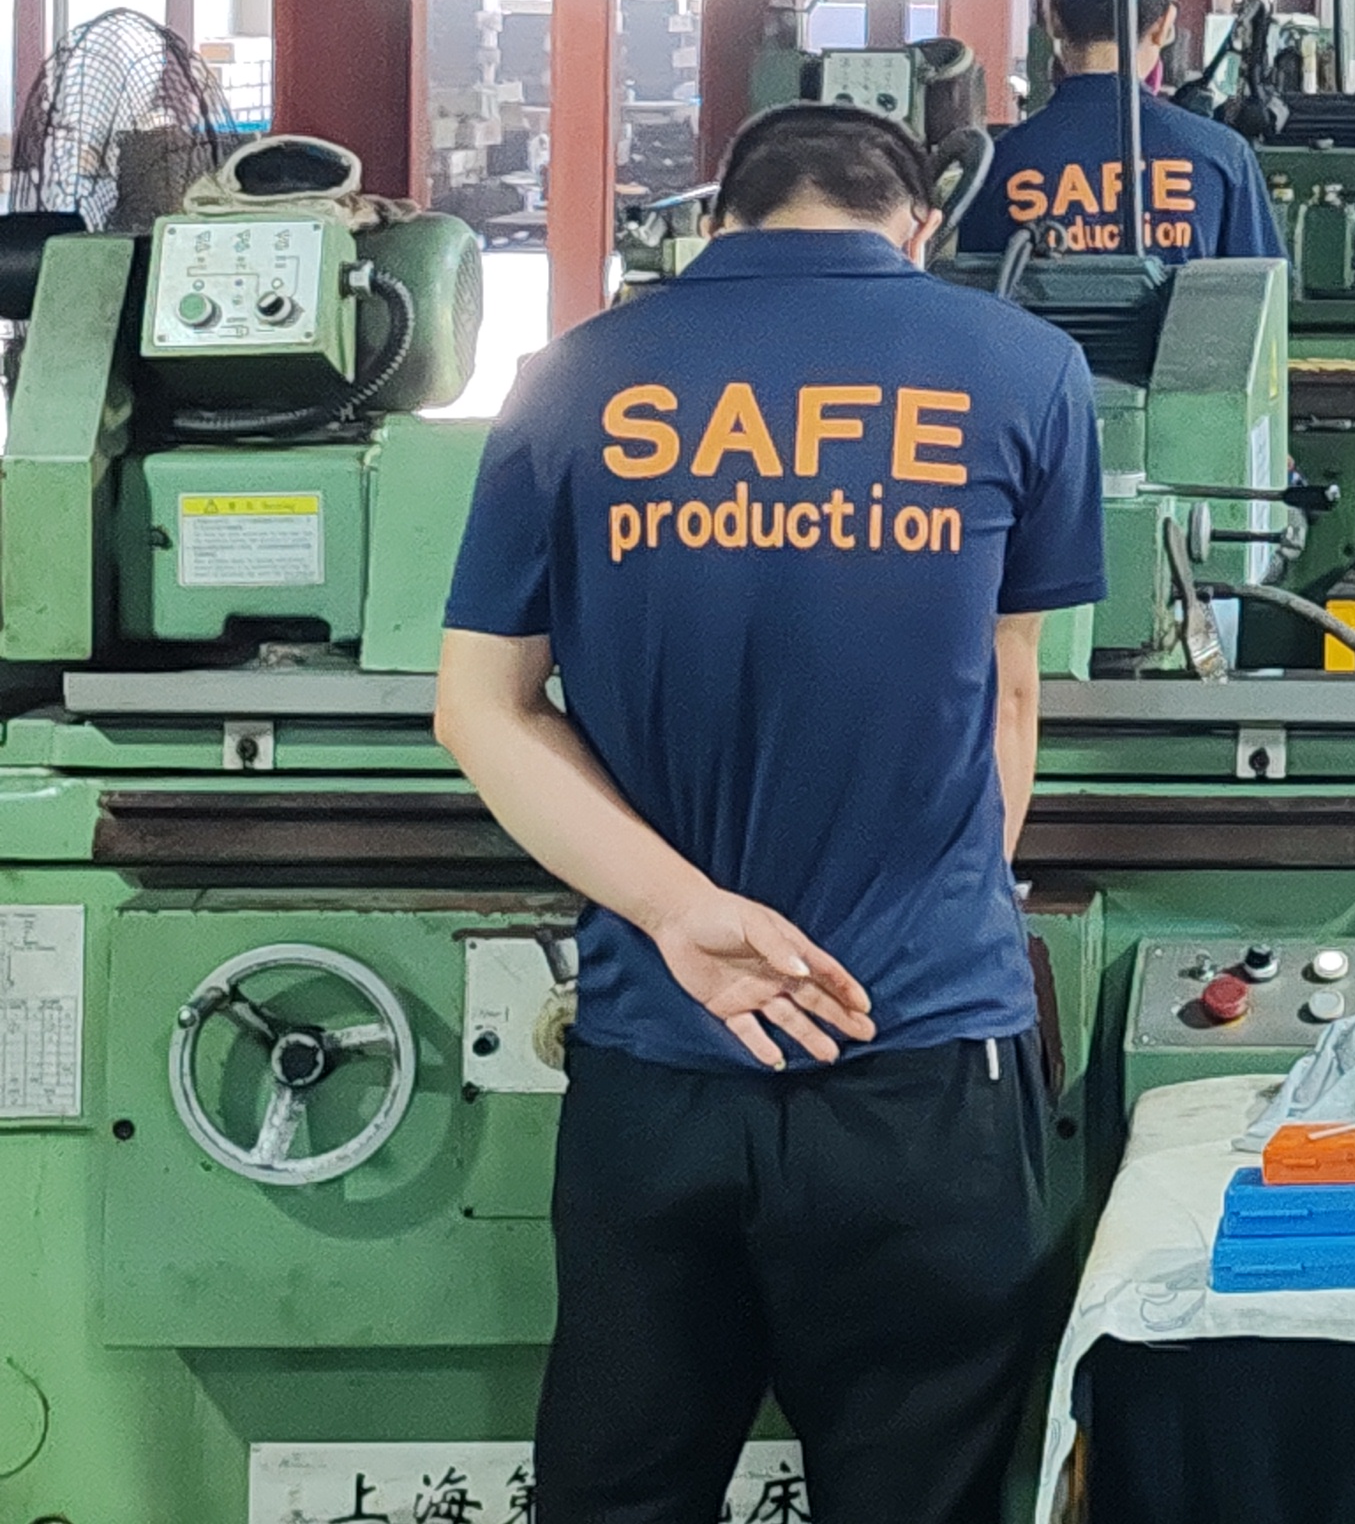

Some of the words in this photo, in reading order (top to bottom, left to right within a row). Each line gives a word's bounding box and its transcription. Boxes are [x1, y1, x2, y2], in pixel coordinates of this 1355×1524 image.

[1006, 159, 1195, 222] SAFE
[602, 382, 971, 486] SAFE
[609, 480, 962, 564] production
